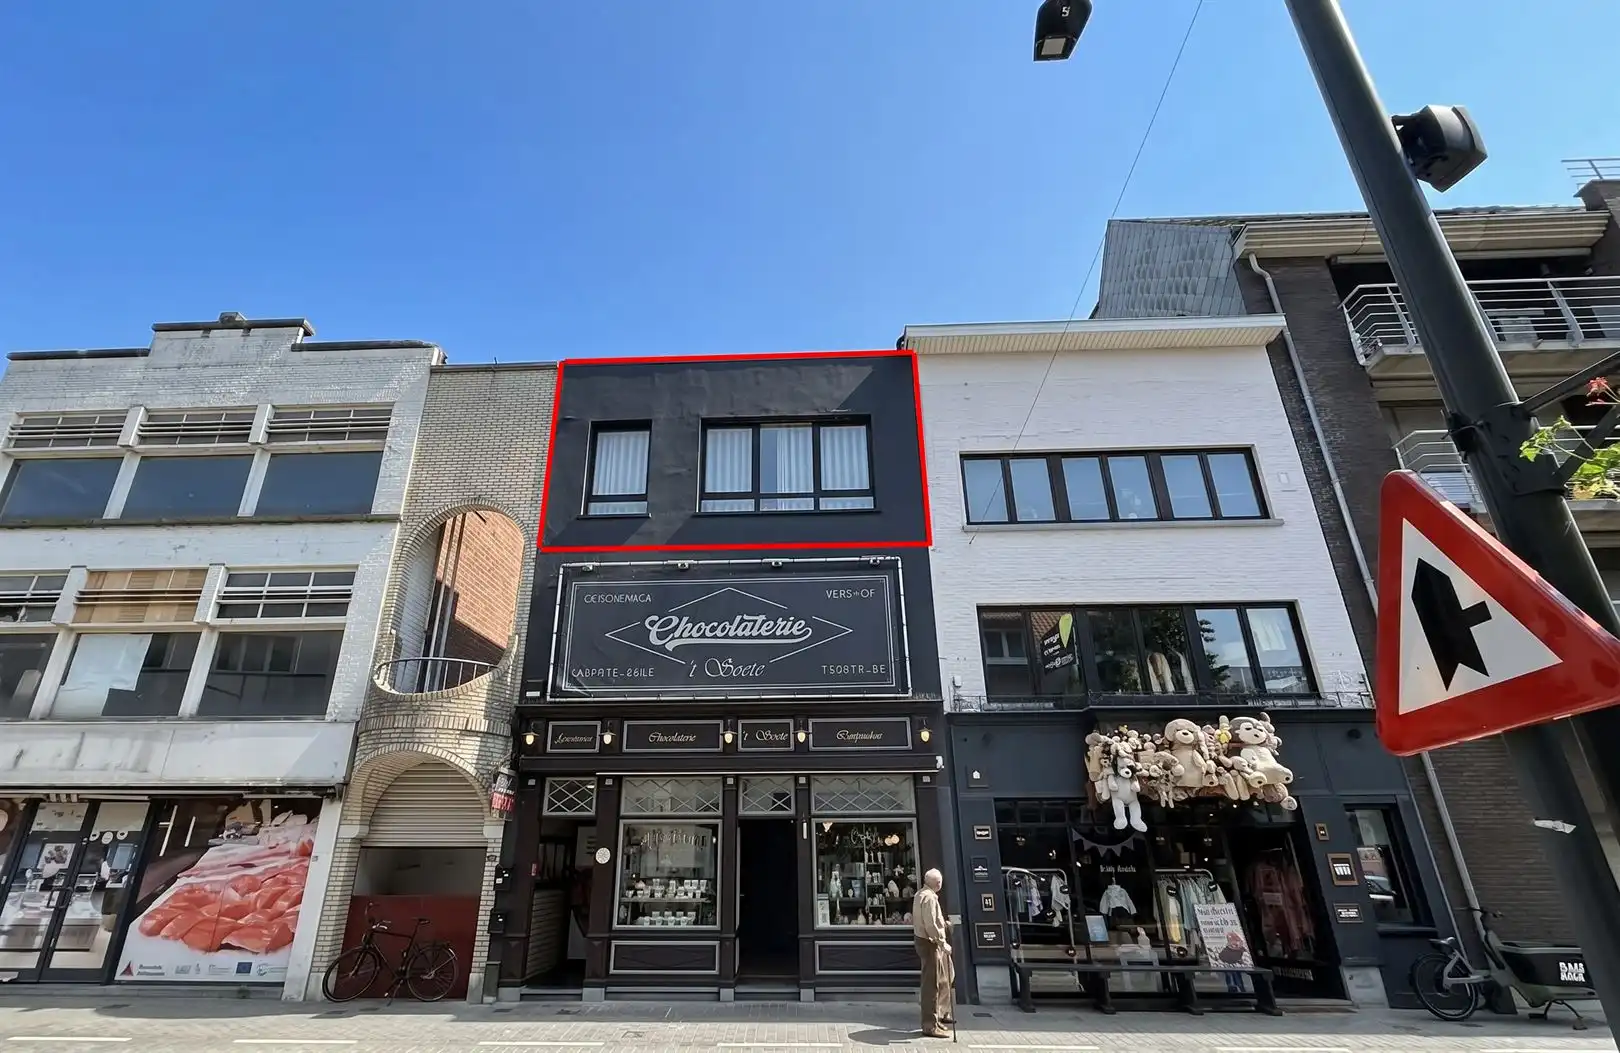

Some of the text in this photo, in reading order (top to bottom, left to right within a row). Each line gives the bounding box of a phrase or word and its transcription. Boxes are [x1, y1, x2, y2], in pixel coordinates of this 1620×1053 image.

[644, 614, 813, 651] Chocolaterie
[704, 657, 766, 678] Soete
[648, 731, 697, 744] Chocolaterie
